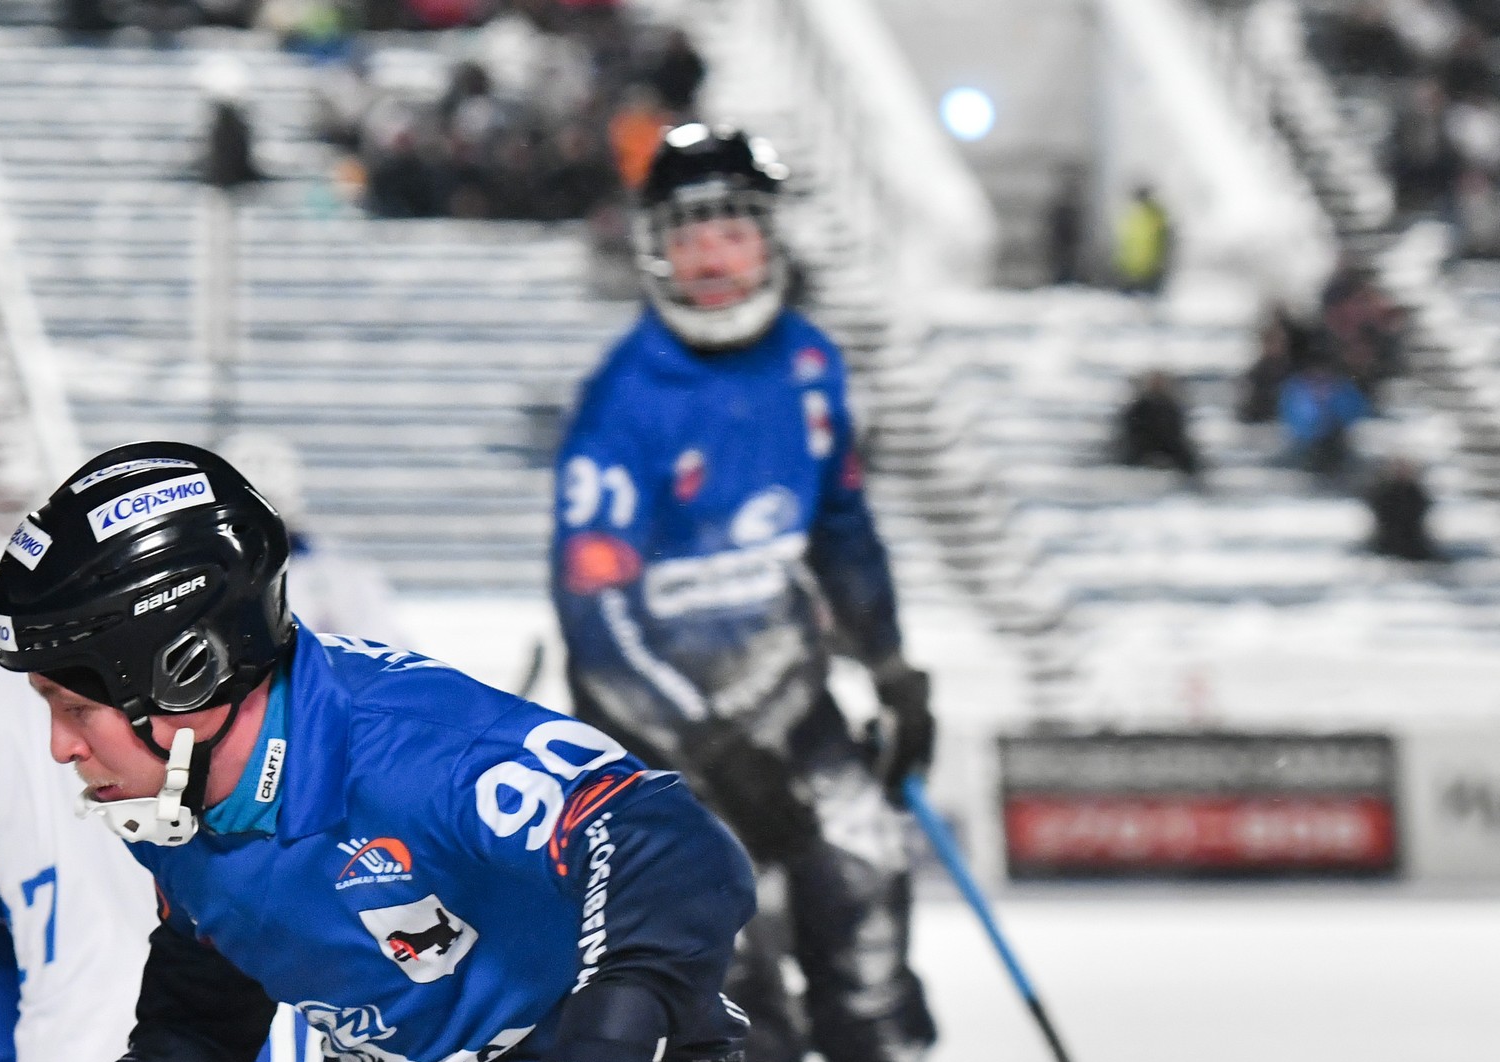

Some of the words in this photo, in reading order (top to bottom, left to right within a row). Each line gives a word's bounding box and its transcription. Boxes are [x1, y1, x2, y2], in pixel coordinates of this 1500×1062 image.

[133, 575, 206, 617] BAUER
[261, 755, 279, 799] CRAFT
[474, 719, 629, 851] 90
